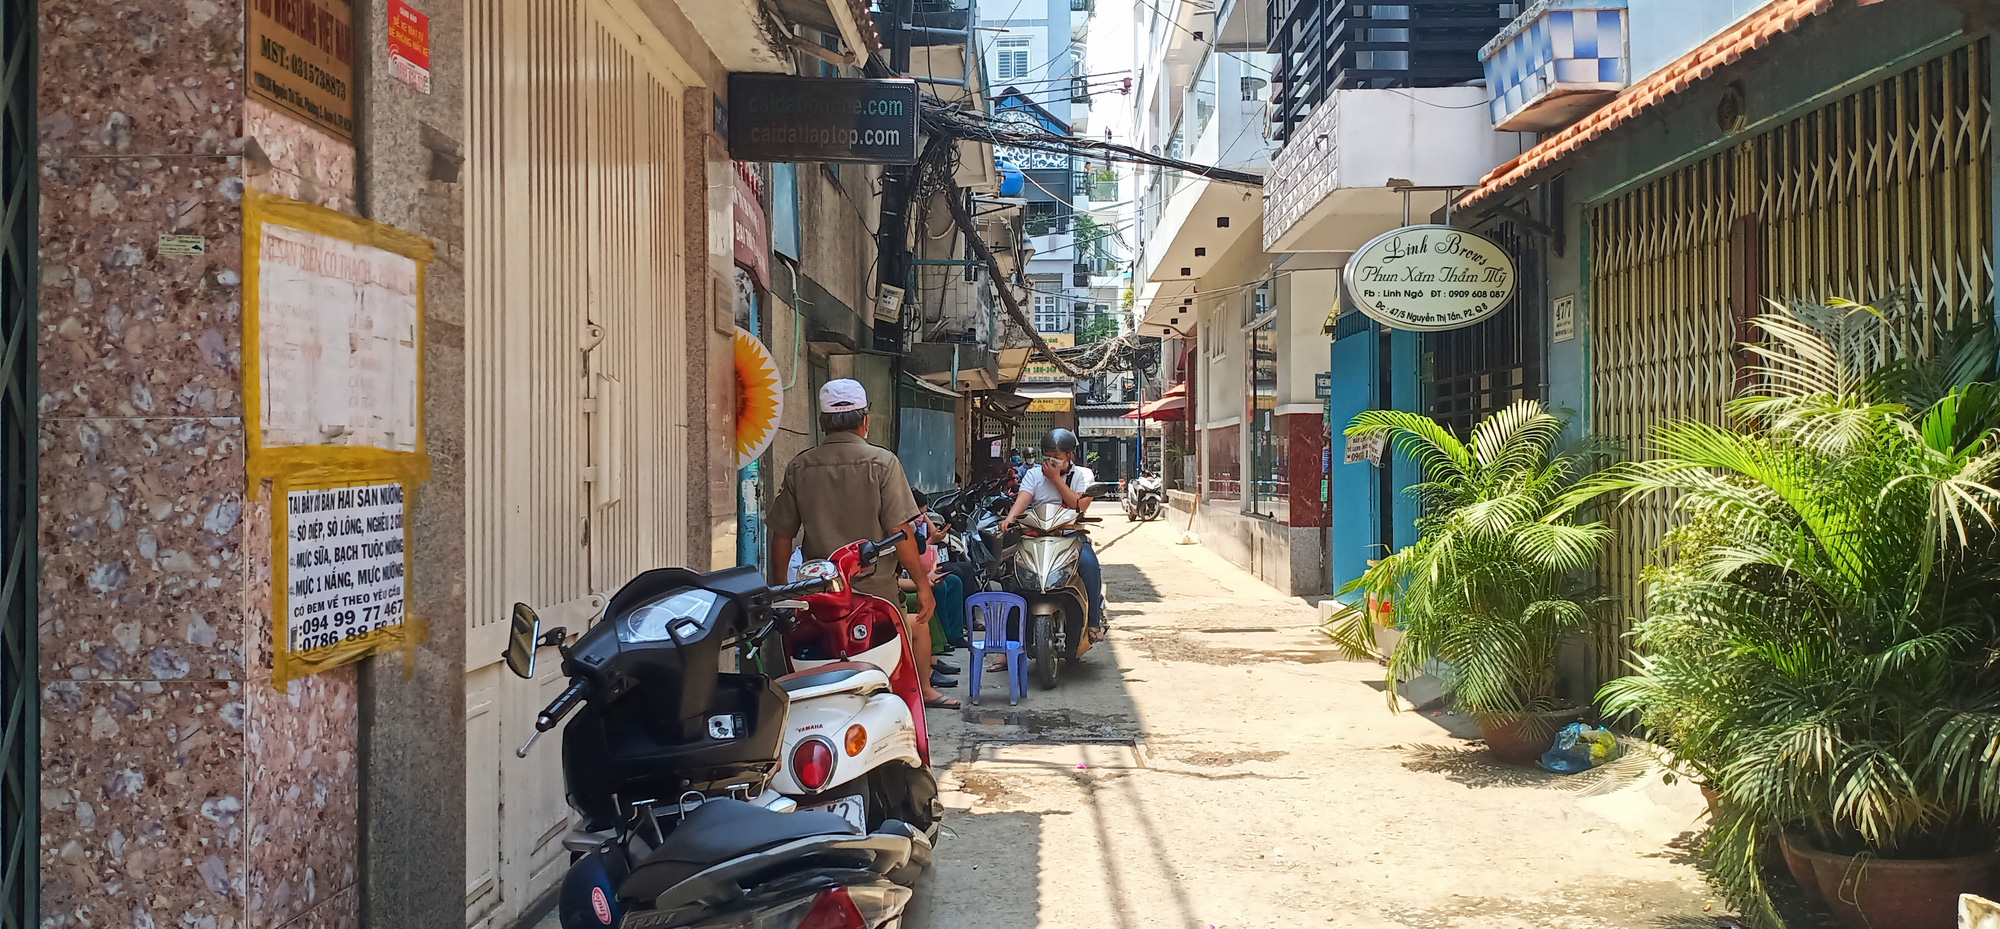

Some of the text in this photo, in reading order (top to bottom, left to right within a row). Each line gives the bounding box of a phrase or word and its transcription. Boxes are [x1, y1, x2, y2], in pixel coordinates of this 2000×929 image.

[261, 34, 289, 70] MST:
[291, 53, 346, 101] 0315738873
[751, 125, 900, 149] caidatlaptop.com
[1382, 233, 1489, 266] Linh Brows
[1360, 266, 1508, 288] Phun Xăm Thẩm Mỹ
[1383, 290, 1401, 298] Linh
[1404, 290, 1424, 299] Ngô
[1430, 290, 1442, 298] ĐT
[1448, 290, 1470, 298] 0909
[1471, 290, 1488, 298] 608
[1489, 290, 1506, 298] 087
[1389, 307, 1406, 319] 47/5
[1406, 313, 1435, 323] Nguyễn
[1436, 314, 1447, 323] Thị
[1463, 308, 1475, 318] P2,
[357, 482, 379, 507] SẢN
[297, 520, 307, 542] SÒ
[327, 515, 338, 537] SÒ
[340, 515, 364, 536] LÔNG,
[390, 515, 394, 530] 2
[296, 549, 313, 571] MỰC
[313, 546, 332, 566] SỮA,
[334, 545, 358, 565] BẠCH
[361, 539, 384, 560] TUỘC
[296, 576, 314, 599] MỰC
[316, 576, 322, 592] 1
[324, 566, 354, 591] NẮNG,
[357, 565, 381, 587] MỰC
[294, 603, 305, 617] CÓ
[307, 601, 325, 614] ĐEM
[327, 594, 339, 609] VỀ
[342, 593, 370, 606] THEO
[373, 589, 388, 602] YÊU
[333, 610, 356, 627] 99
[362, 605, 381, 622] 77
[384, 599, 403, 617] 467
[345, 625, 368, 642] 88
[798, 724, 823, 733] YAMAHA
